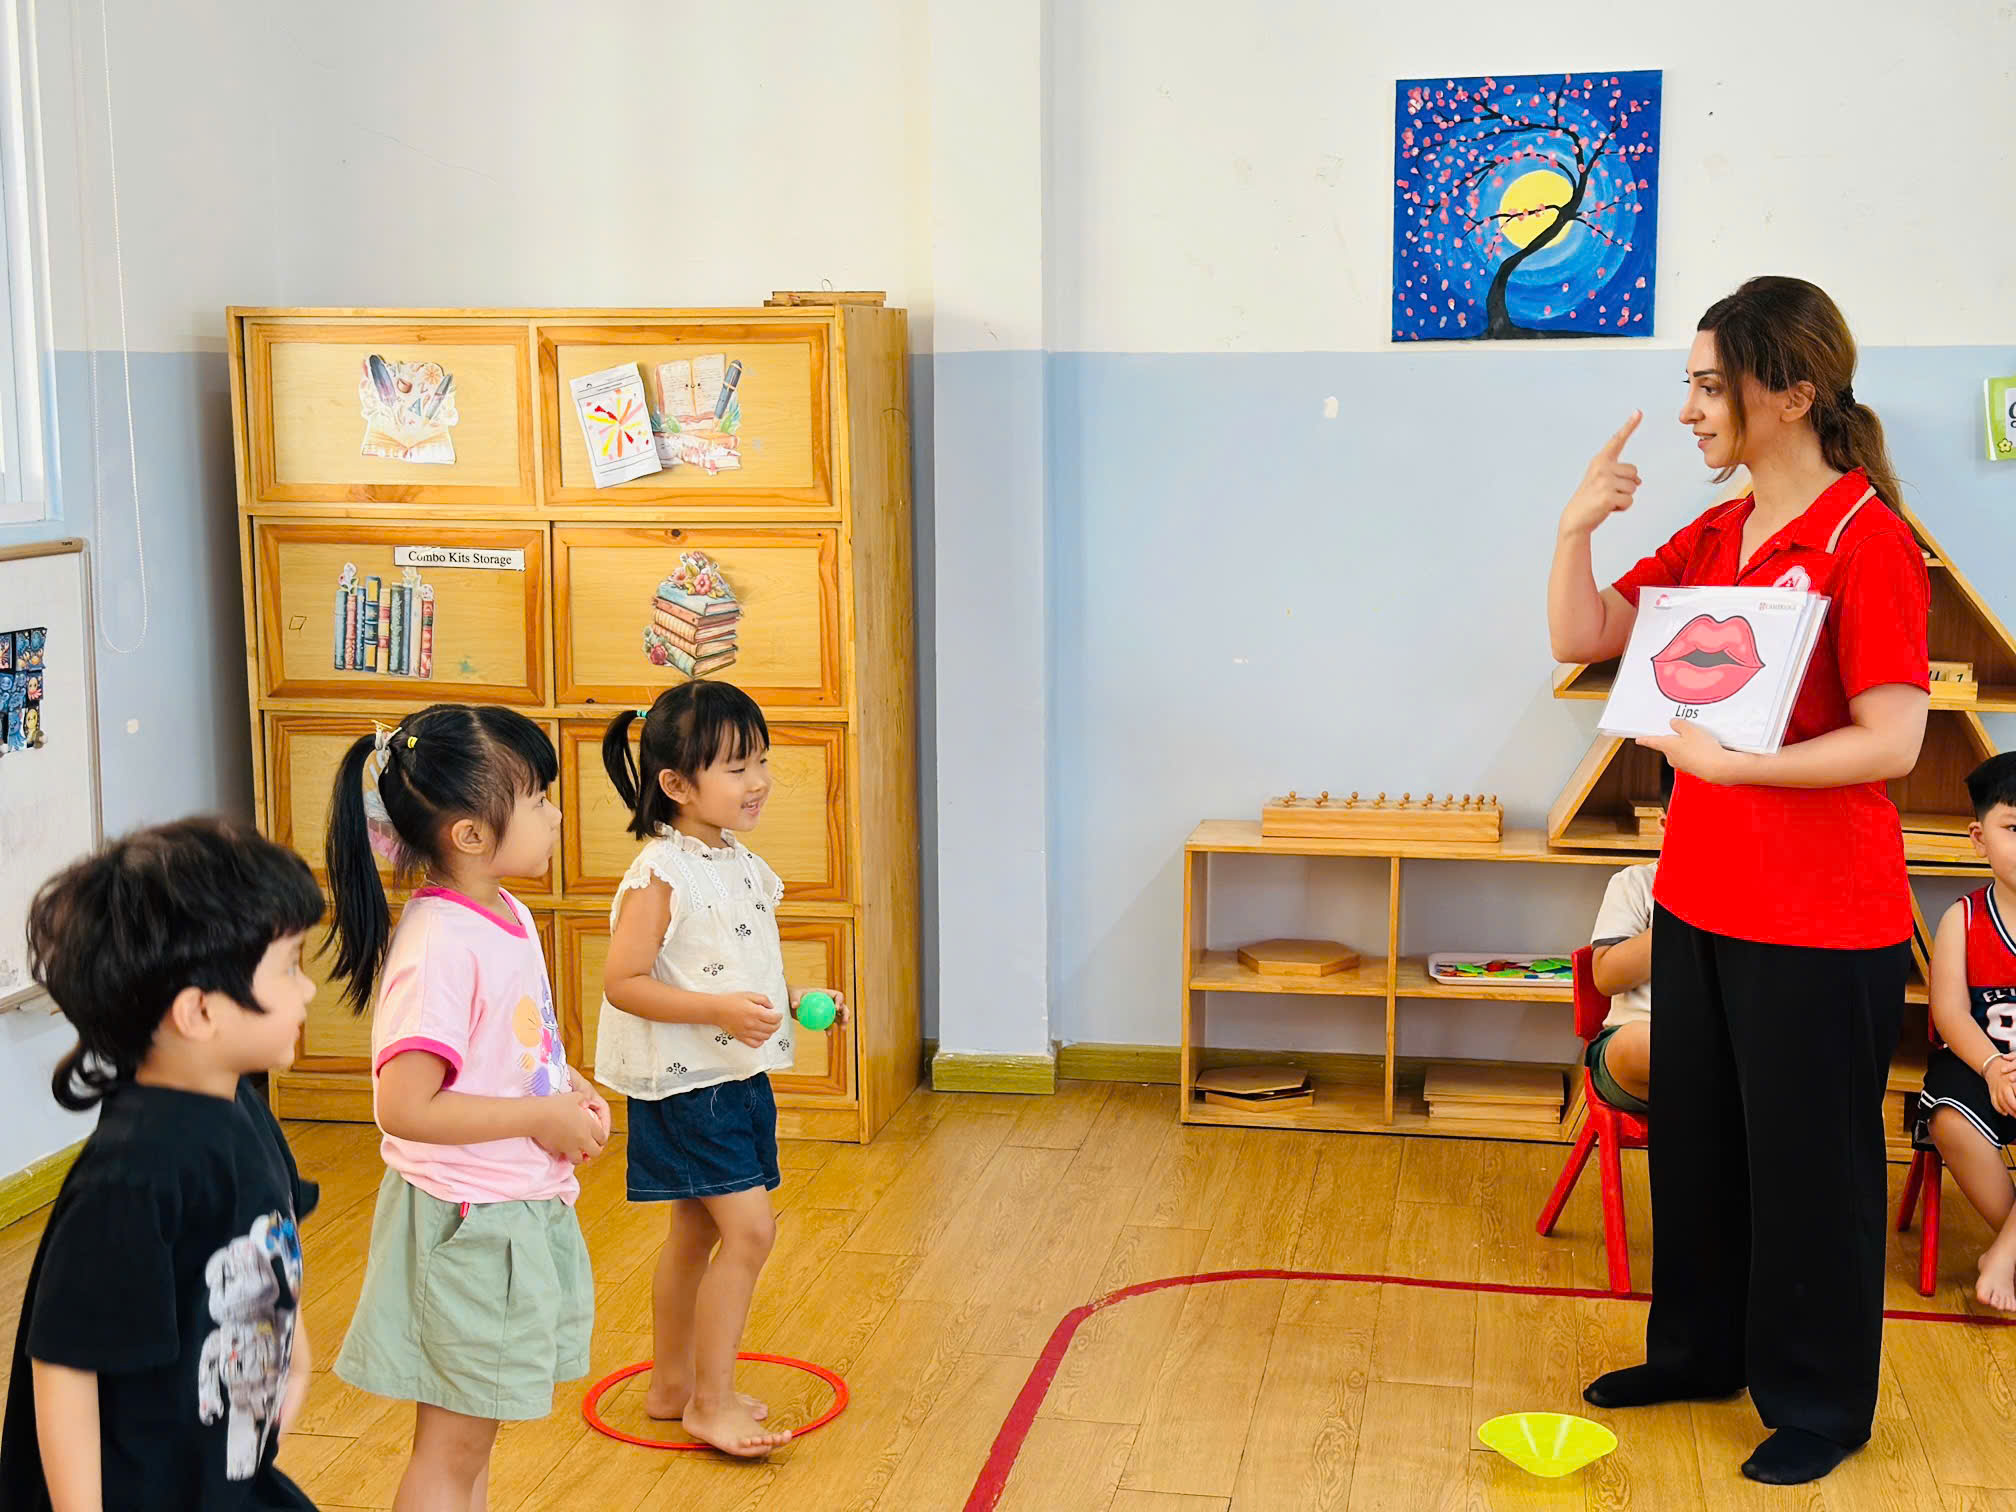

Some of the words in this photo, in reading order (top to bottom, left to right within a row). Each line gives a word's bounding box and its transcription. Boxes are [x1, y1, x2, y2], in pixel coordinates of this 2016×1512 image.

[408, 550, 446, 562] Combo
[448, 552, 470, 563] Kits
[473, 553, 512, 567] Storage
[1675, 704, 1700, 721] Lips
